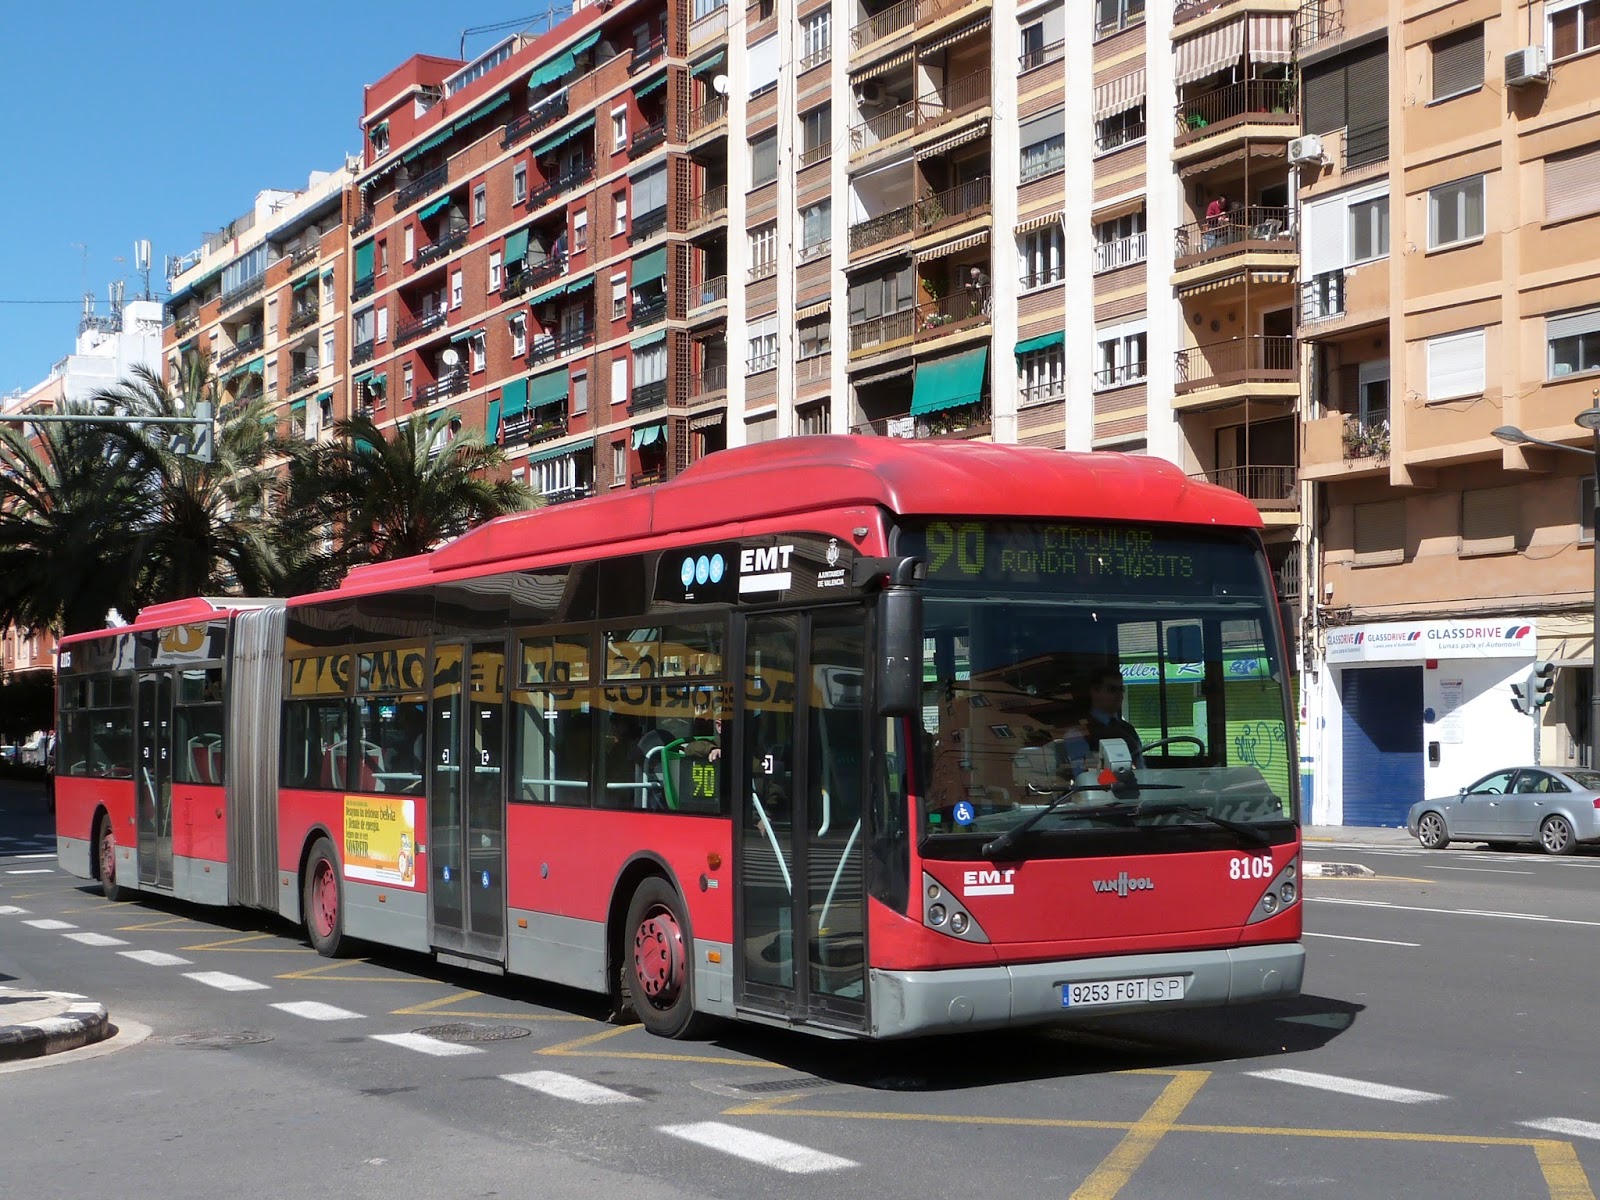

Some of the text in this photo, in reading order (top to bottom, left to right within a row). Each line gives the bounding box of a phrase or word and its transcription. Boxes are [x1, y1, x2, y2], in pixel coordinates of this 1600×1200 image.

[925, 521, 985, 574] 90
[1043, 526, 1152, 551] CIRCULAR
[740, 545, 794, 573] EMT
[1001, 549, 1077, 574] RONDA
[1327, 633, 1354, 646] GLASSDRIVE
[1367, 632, 1406, 642] GLASSDRIVE
[1427, 627, 1502, 640] GLASSDRIVE
[1460, 643, 1476, 652] para
[692, 764, 715, 797] 90
[963, 870, 1015, 885] EMT
[1229, 855, 1273, 880] 8105
[1072, 980, 1180, 1003] 9253 FGT SP
